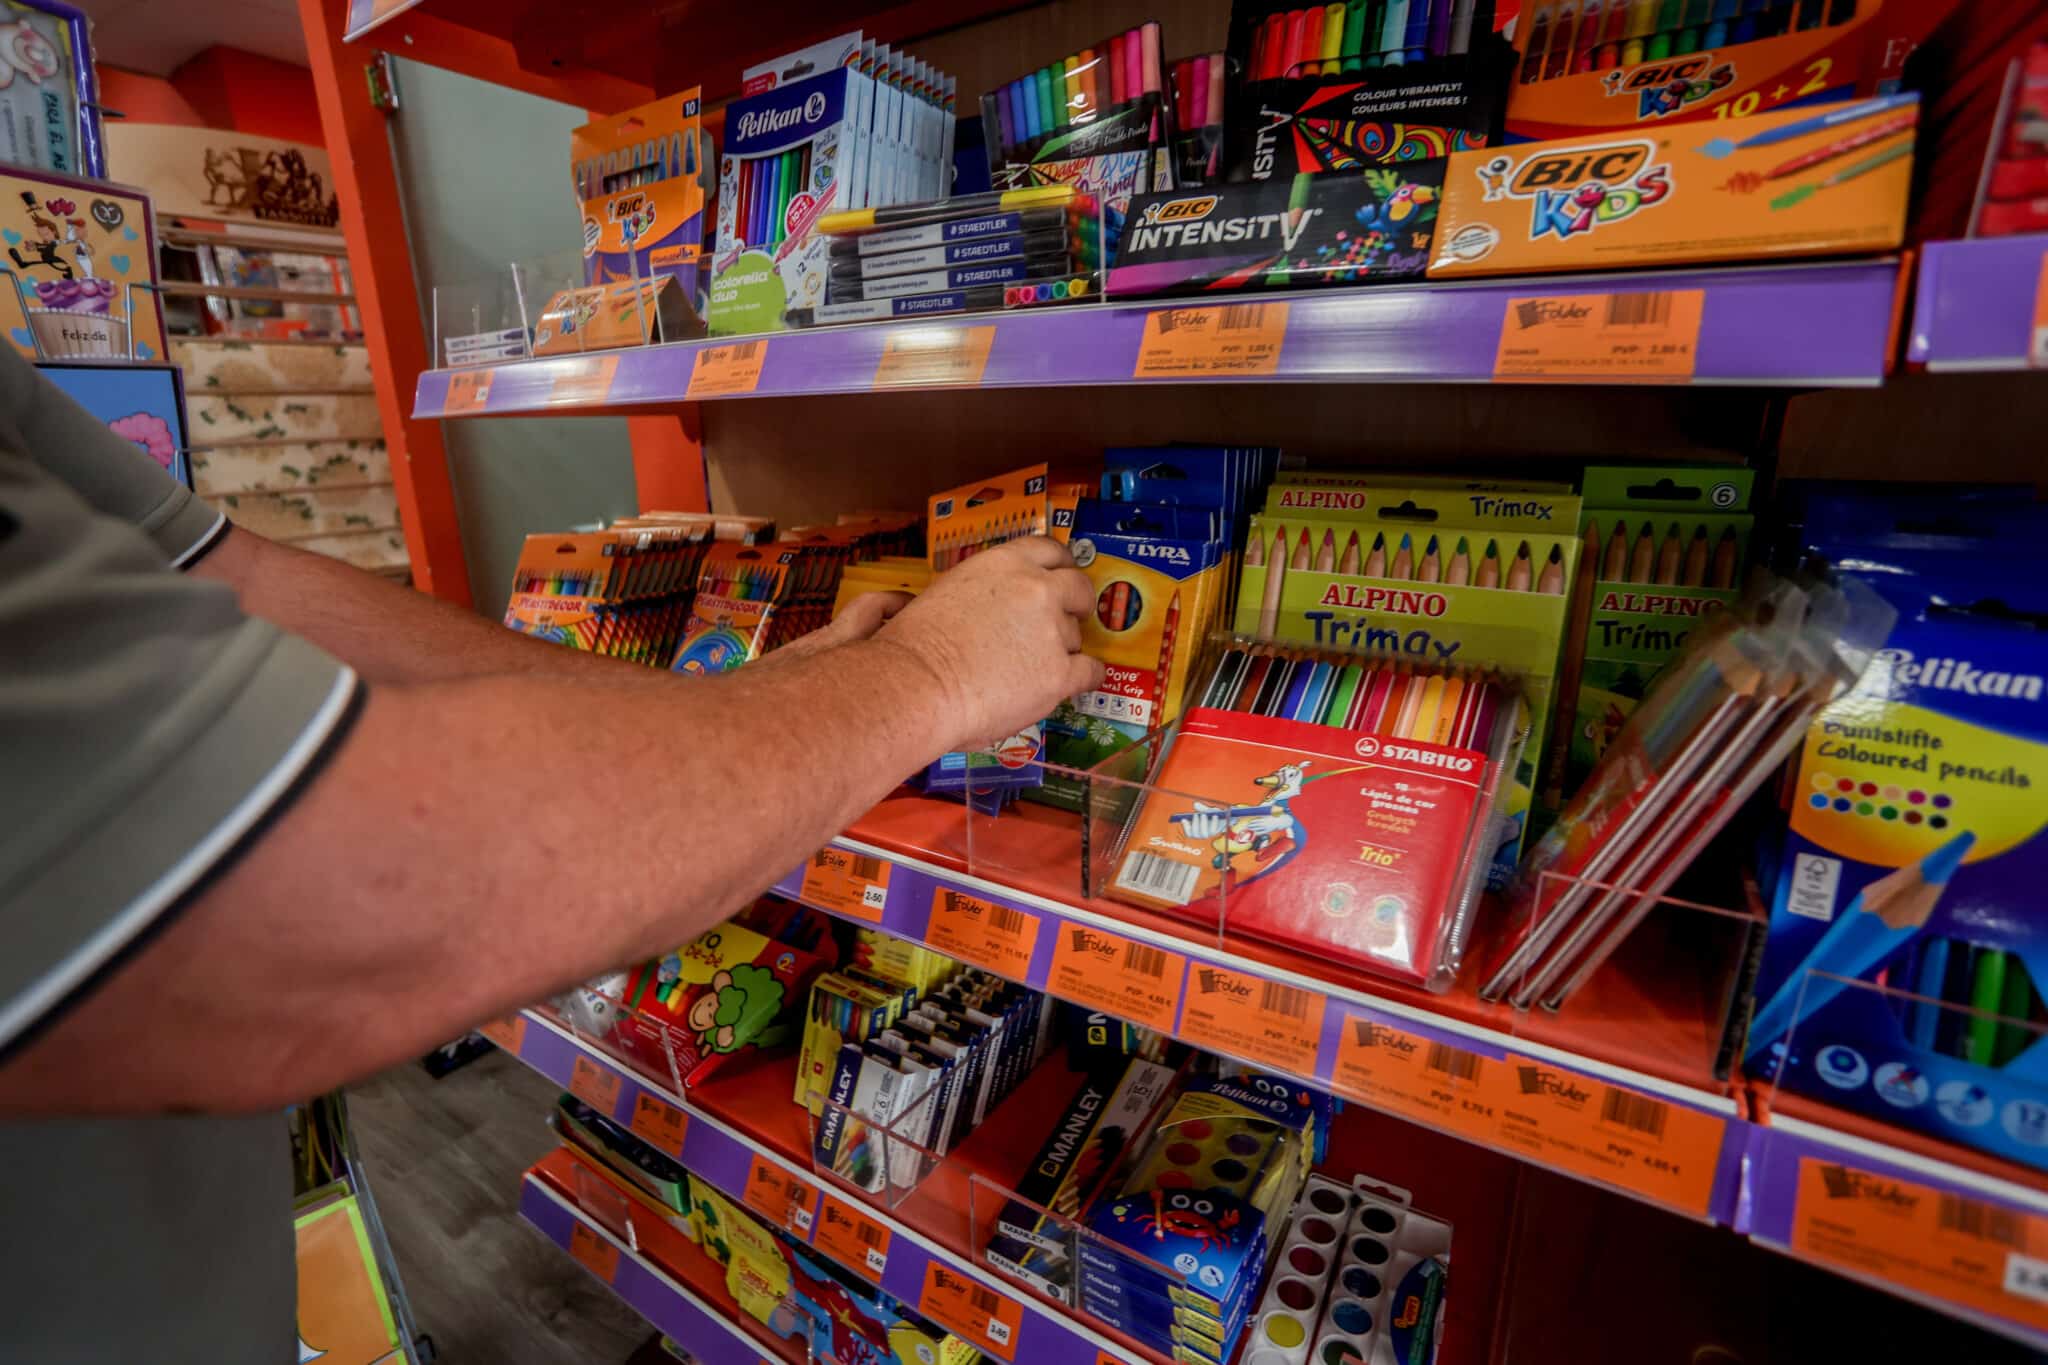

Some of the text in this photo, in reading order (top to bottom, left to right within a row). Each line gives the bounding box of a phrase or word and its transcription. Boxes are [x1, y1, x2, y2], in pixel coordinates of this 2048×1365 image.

[1353, 81, 1463, 102] COLOUR VIBRANTLY!
[1712, 57, 1833, 121] 10 + 2
[685, 101, 696, 117] 10
[1351, 100, 1408, 115] COULEURS
[1408, 95, 1460, 110] INTENSES
[735, 105, 803, 143] Pelikan
[957, 218, 1009, 235] STAEDTLER
[960, 242, 1011, 259] STAEDTLER
[713, 271, 769, 291] colorella
[963, 267, 1014, 283] STAEDTLER
[712, 289, 739, 304] duo
[907, 297, 954, 311] STAEDTLER
[61, 328, 89, 342] Feliz
[1026, 478, 1043, 494] 12
[1717, 488, 1732, 503] 6
[1279, 490, 1366, 511] ALPINO
[1469, 495, 1553, 520] Trimax
[1054, 510, 1071, 527] 12
[1137, 543, 1192, 561] LYRA
[1320, 583, 1448, 617] ALPINO
[1303, 611, 1462, 659] Trimax
[1871, 646, 2044, 702] Pelikan
[1122, 683, 1145, 699] Grip
[1128, 702, 1143, 717] 10
[1381, 744, 1473, 773] STABILO
[1817, 740, 2032, 790] Coloured pencils
[1396, 794, 1412, 805] de
[1359, 845, 1395, 866] Trio
[864, 890, 884, 904] 2.50
[955, 894, 985, 915] Folder
[1083, 932, 1117, 957] Folder
[1213, 974, 1254, 998] Folder
[1372, 1025, 1419, 1055] Folder
[1209, 1082, 1269, 1107] Pelikan
[1536, 1071, 1591, 1105] Folder
[826, 1067, 853, 1141] MANLEY
[1051, 1087, 1104, 1165] MANLEY
[1182, 1254, 1195, 1267] 12
